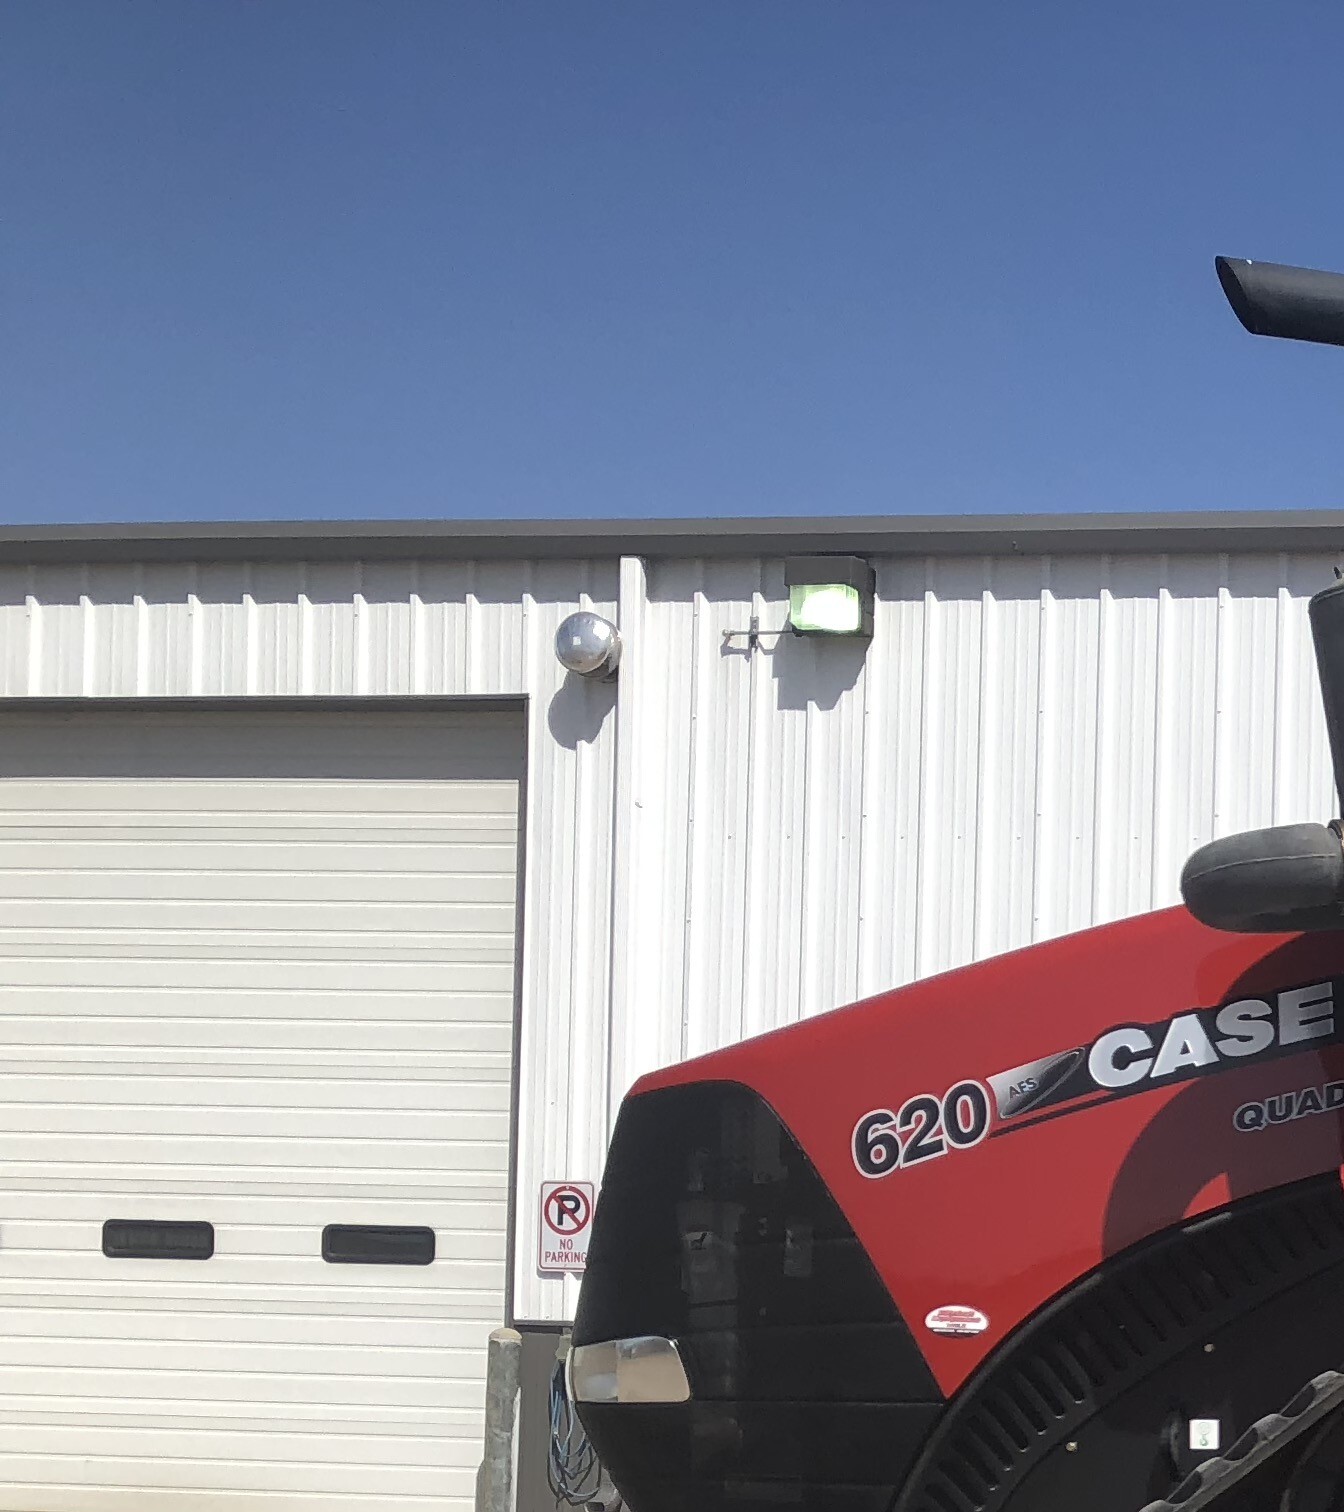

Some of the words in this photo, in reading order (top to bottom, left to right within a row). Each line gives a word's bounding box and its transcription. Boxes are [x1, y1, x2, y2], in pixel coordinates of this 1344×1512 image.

[1088, 982, 1335, 1088] CASE
[1008, 1077, 1038, 1098] AFS
[851, 1079, 992, 1179] 620
[559, 1239, 573, 1250] NO
[544, 1251, 587, 1263] PARKING
